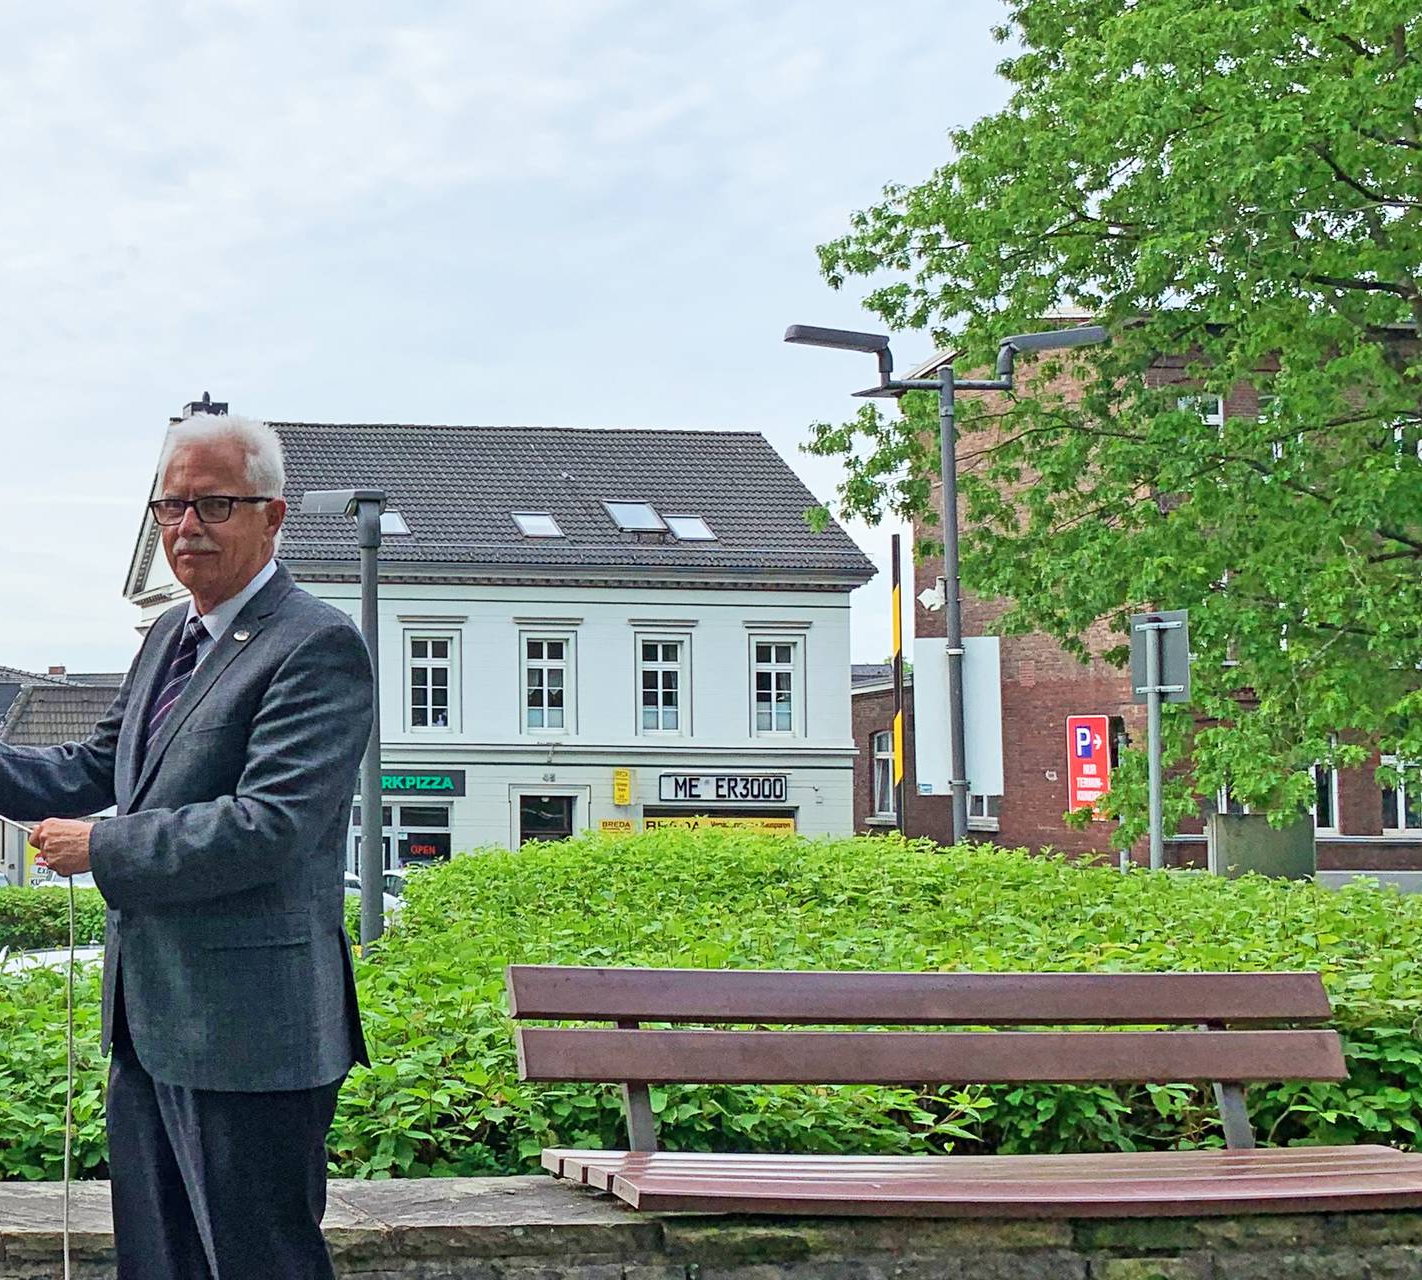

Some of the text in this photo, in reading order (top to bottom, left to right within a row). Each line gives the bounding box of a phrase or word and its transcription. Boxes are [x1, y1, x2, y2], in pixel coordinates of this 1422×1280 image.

[1076, 727, 1091, 757] P
[381, 775, 454, 790] RKPIZZA
[674, 777, 784, 799] ME ER3000
[601, 821, 631, 829] BREDA
[410, 845, 436, 855] OPEN
